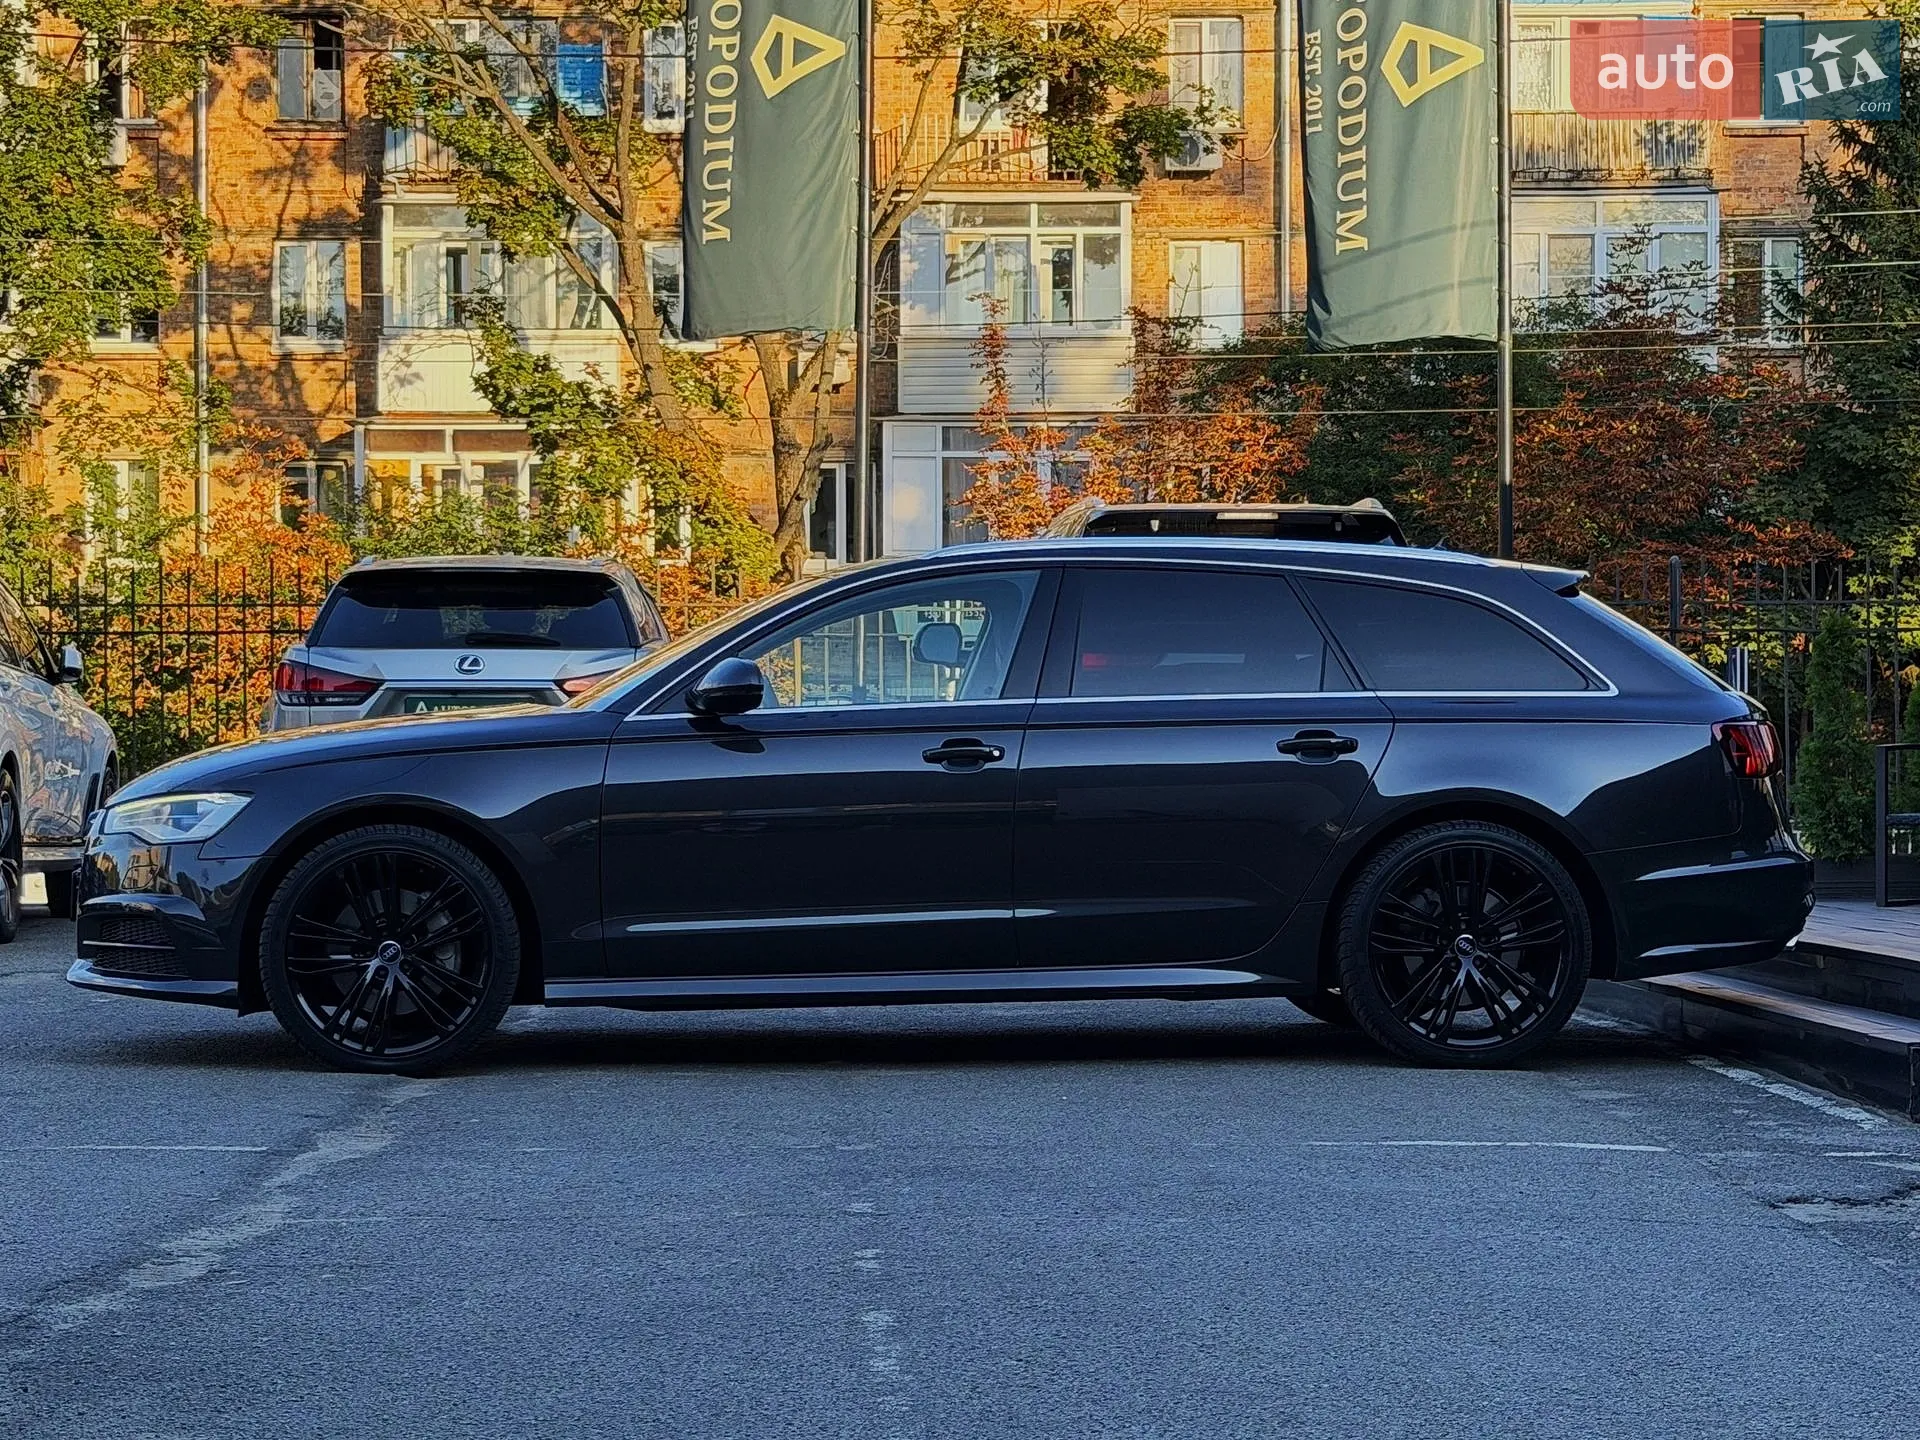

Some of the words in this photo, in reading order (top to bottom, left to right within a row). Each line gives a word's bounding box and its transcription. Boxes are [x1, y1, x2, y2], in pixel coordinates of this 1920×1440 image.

[1304, 28, 1322, 82] EST.
[1305, 84, 1323, 137] 2011
[1336, 0, 1368, 256] OPODIUM
